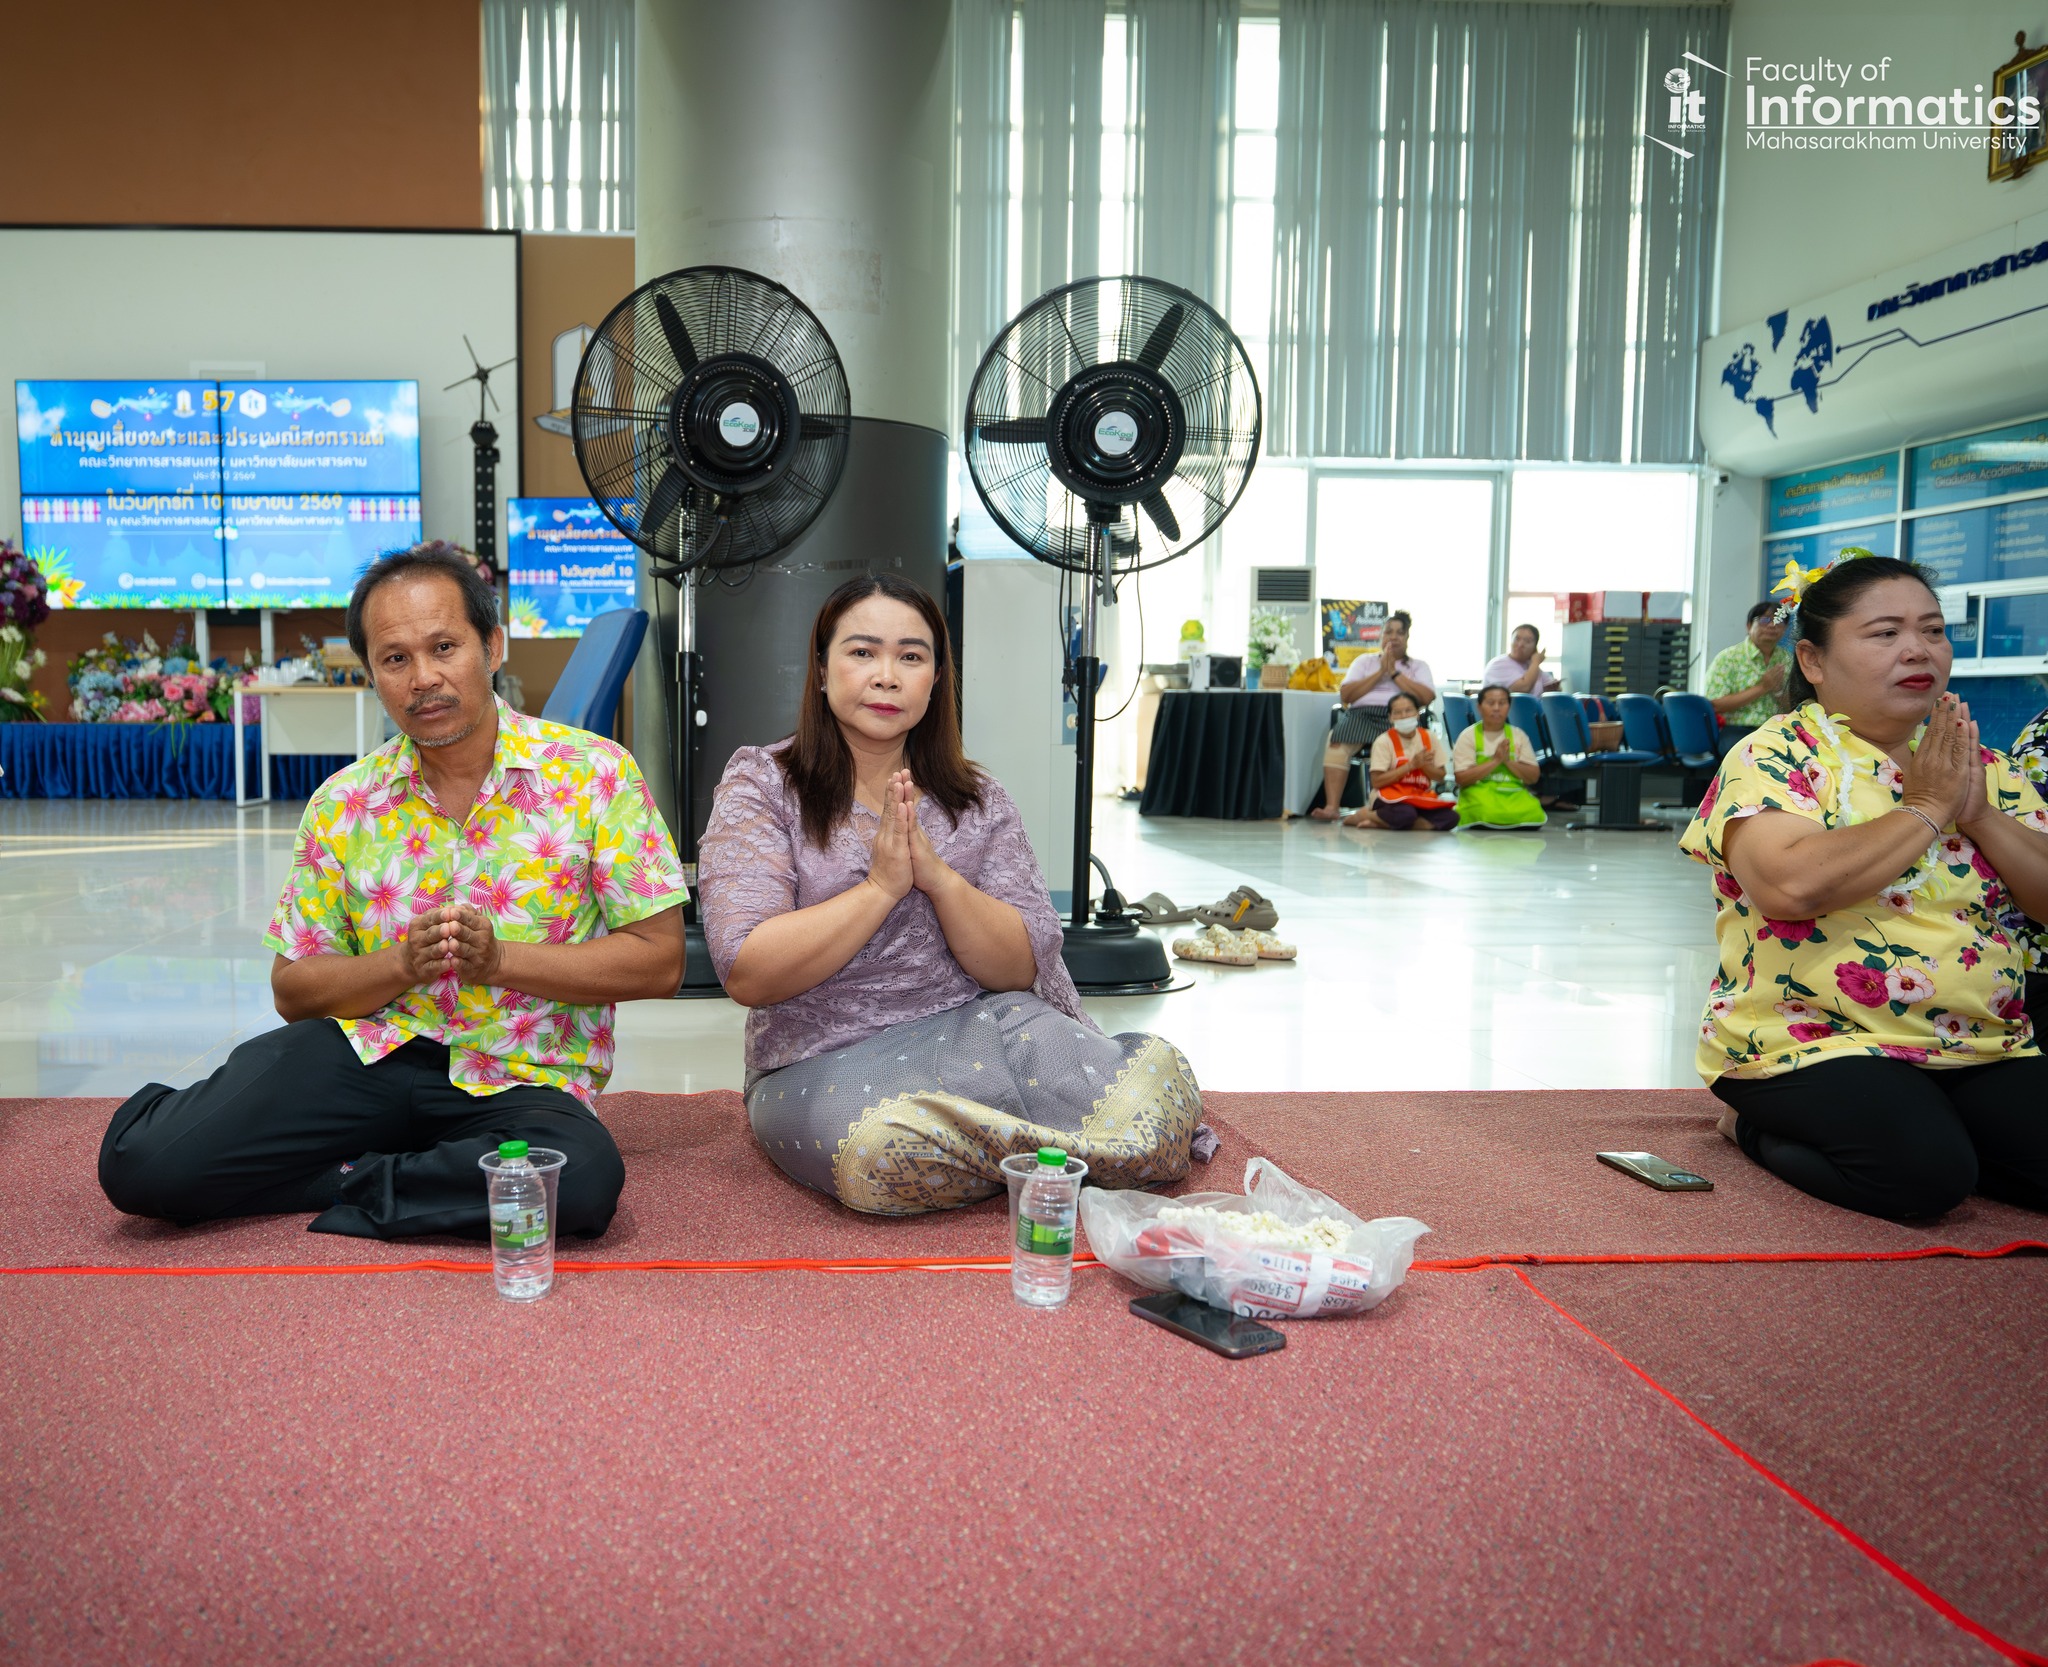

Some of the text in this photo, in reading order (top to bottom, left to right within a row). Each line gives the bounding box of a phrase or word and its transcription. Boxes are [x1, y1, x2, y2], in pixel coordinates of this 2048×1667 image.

[202, 389, 235, 412] 57
[1935, 471, 1977, 489] Graduate
[1979, 460, 2025, 480] Academic
[201, 493, 224, 511] 10
[231, 494, 293, 511] เมษายน
[299, 493, 343, 511] 2569
[619, 566, 633, 577] 10
